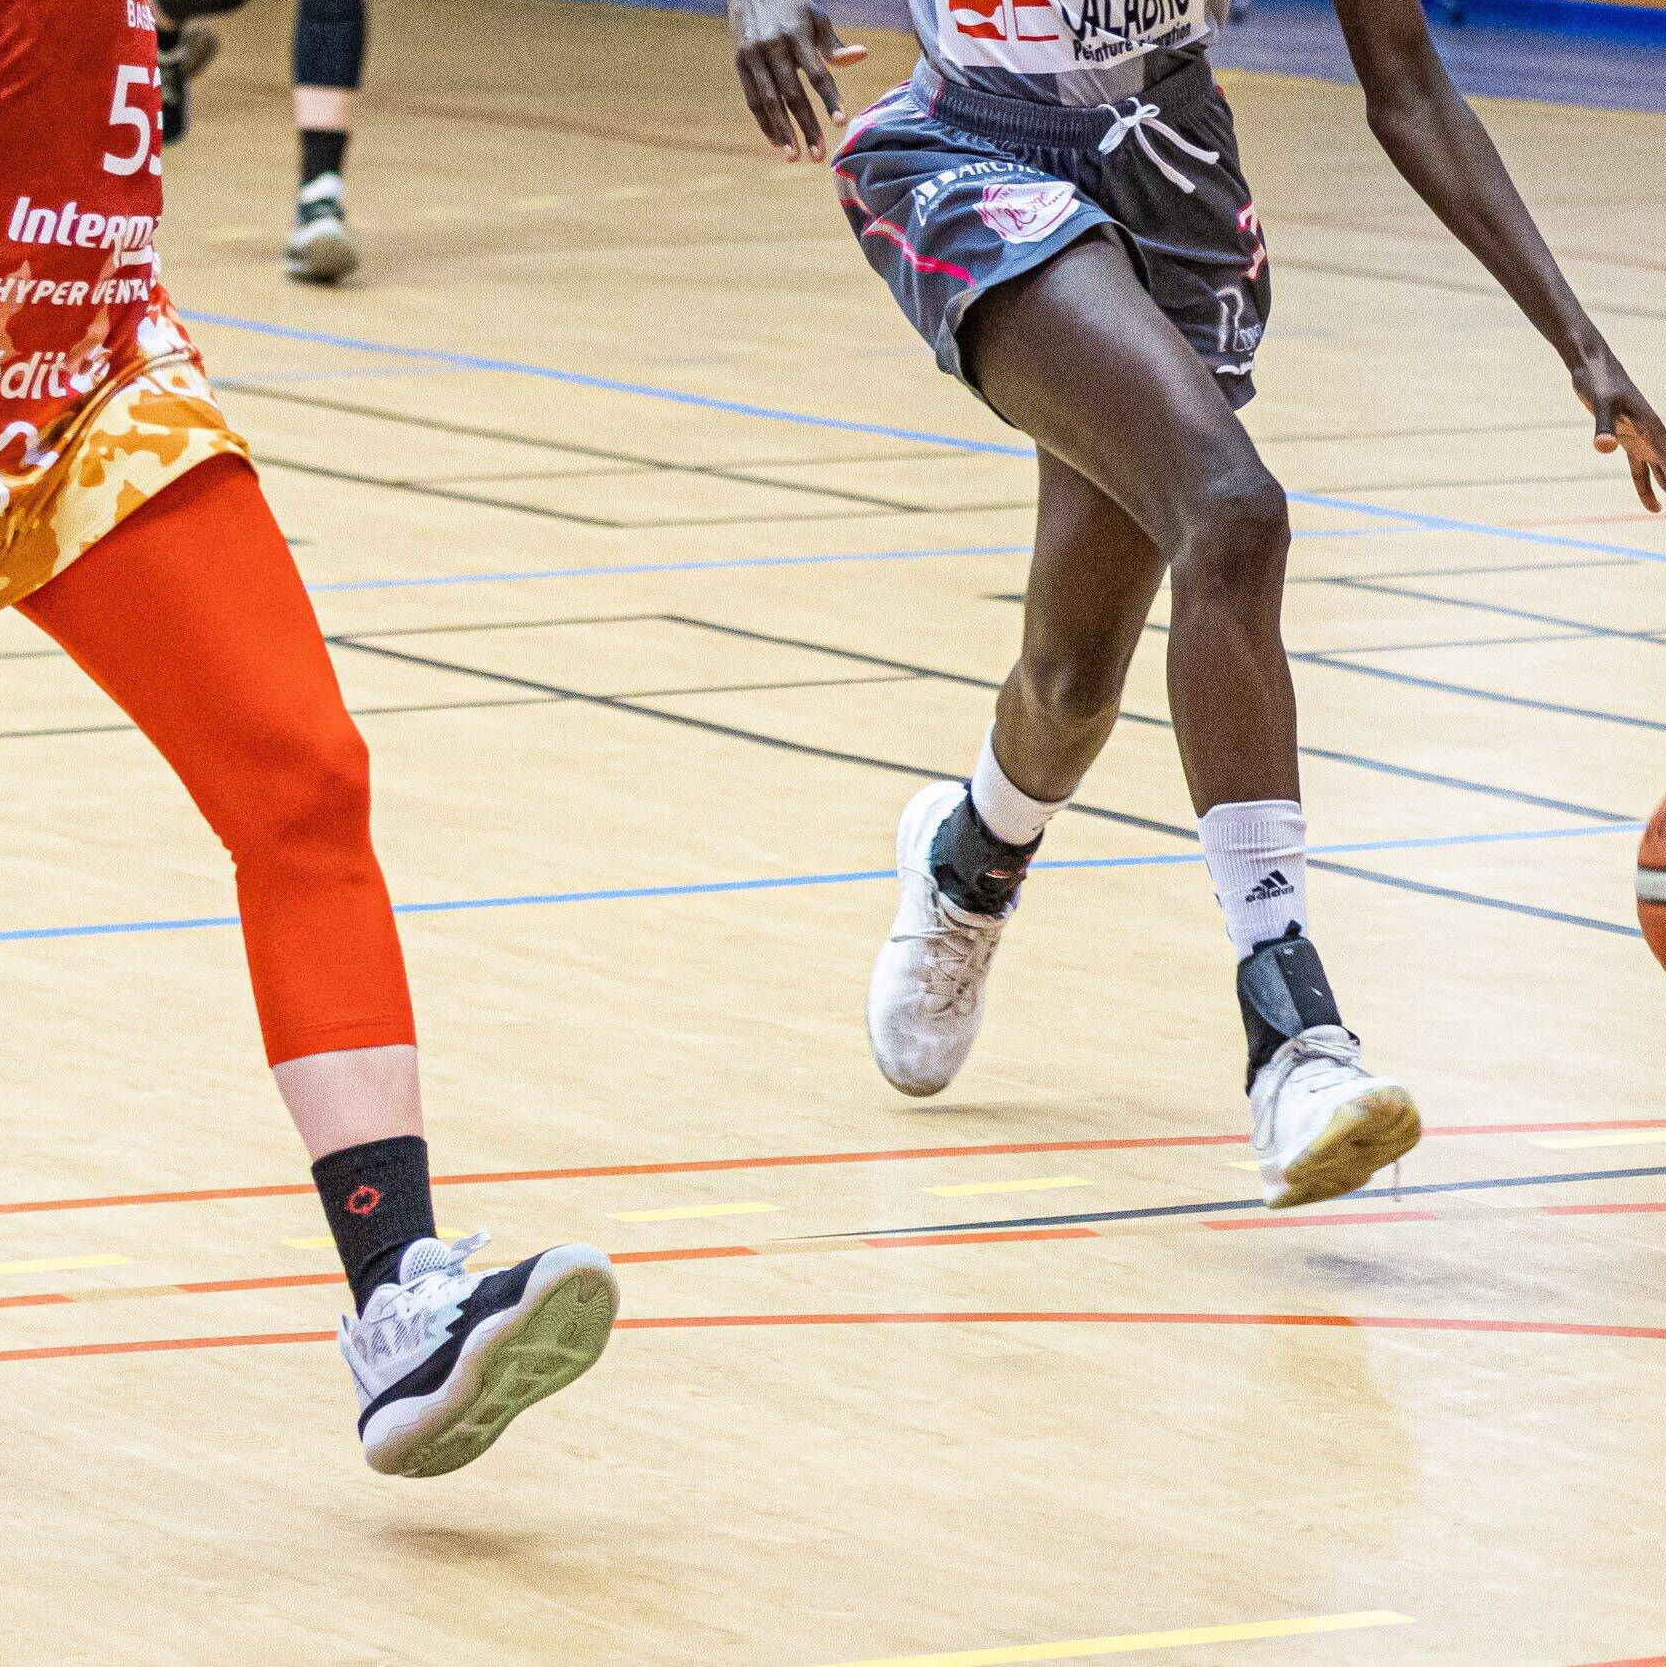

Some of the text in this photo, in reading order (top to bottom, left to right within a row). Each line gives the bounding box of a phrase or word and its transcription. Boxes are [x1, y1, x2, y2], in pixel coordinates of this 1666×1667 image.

[1073, 38, 1134, 63] Peinture
[7, 195, 162, 264] Interm
[91, 275, 149, 305] VENTA
